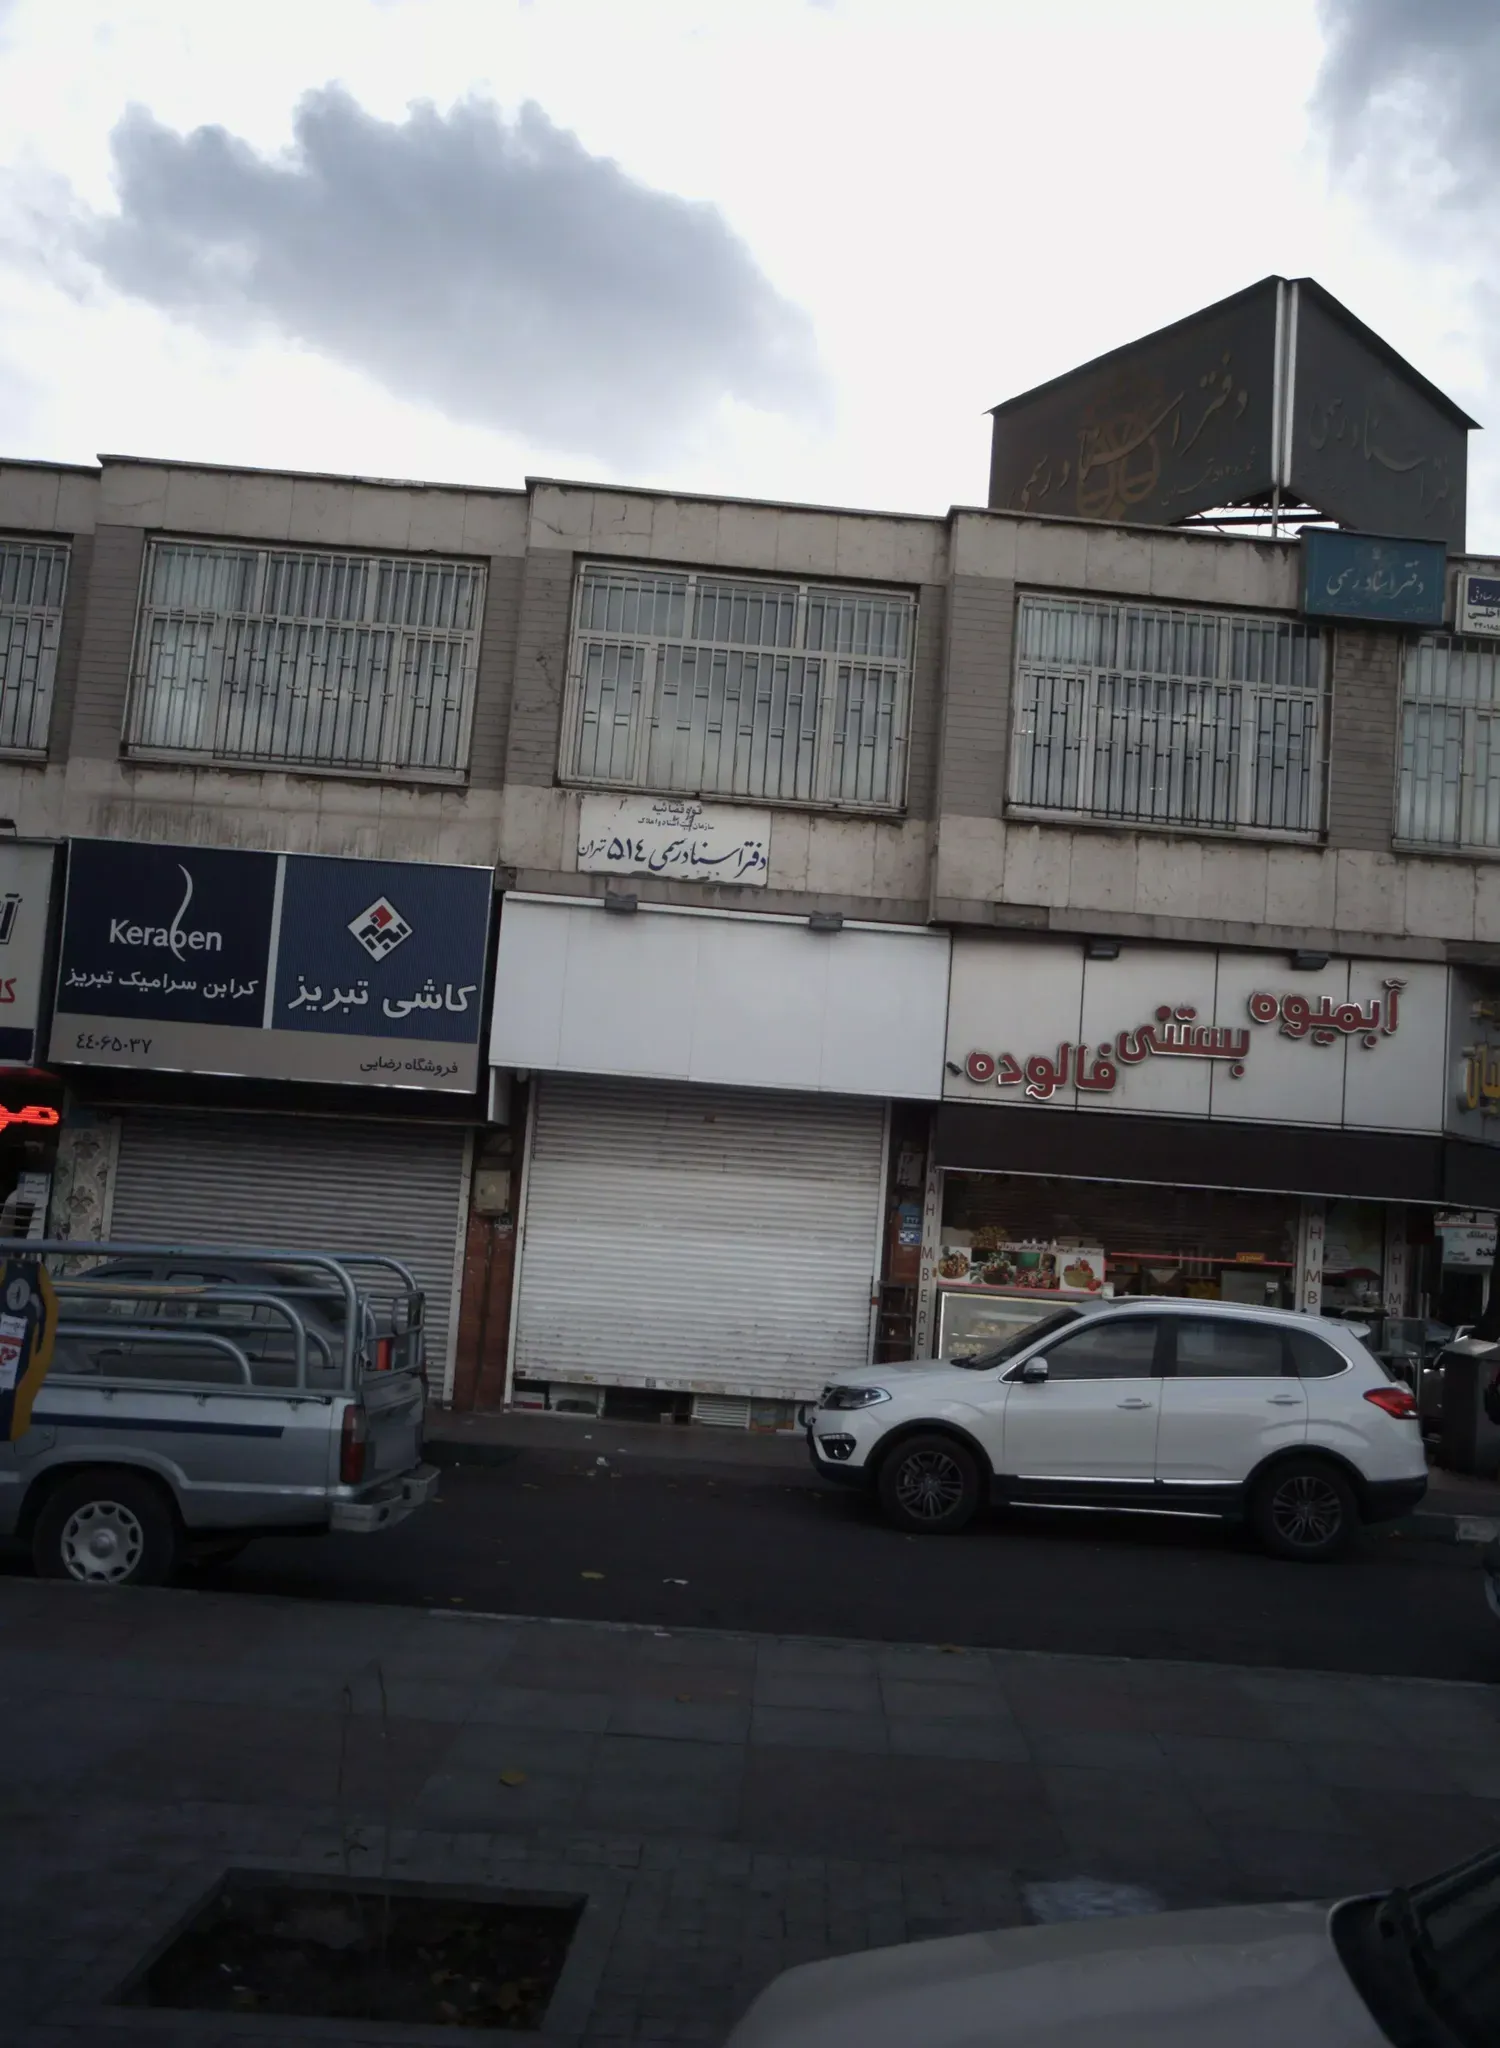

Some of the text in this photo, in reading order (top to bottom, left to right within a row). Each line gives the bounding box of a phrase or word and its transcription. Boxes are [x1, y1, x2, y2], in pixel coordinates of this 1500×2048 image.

[1389, 559, 1425, 600] دفتر
[648, 837, 687, 872] رسمی
[680, 841, 742, 867] اسناد
[733, 841, 767, 879] دفتر
[65, 967, 259, 998] کرابن سرامیک تبریز
[288, 975, 477, 1018] کاشی تبریز
[1248, 977, 1409, 1049] آبمیوه
[1116, 1005, 1251, 1079] بستنی
[359, 1056, 458, 1077] فروشگاه رضایی
[966, 1042, 1116, 1100] فالوده
